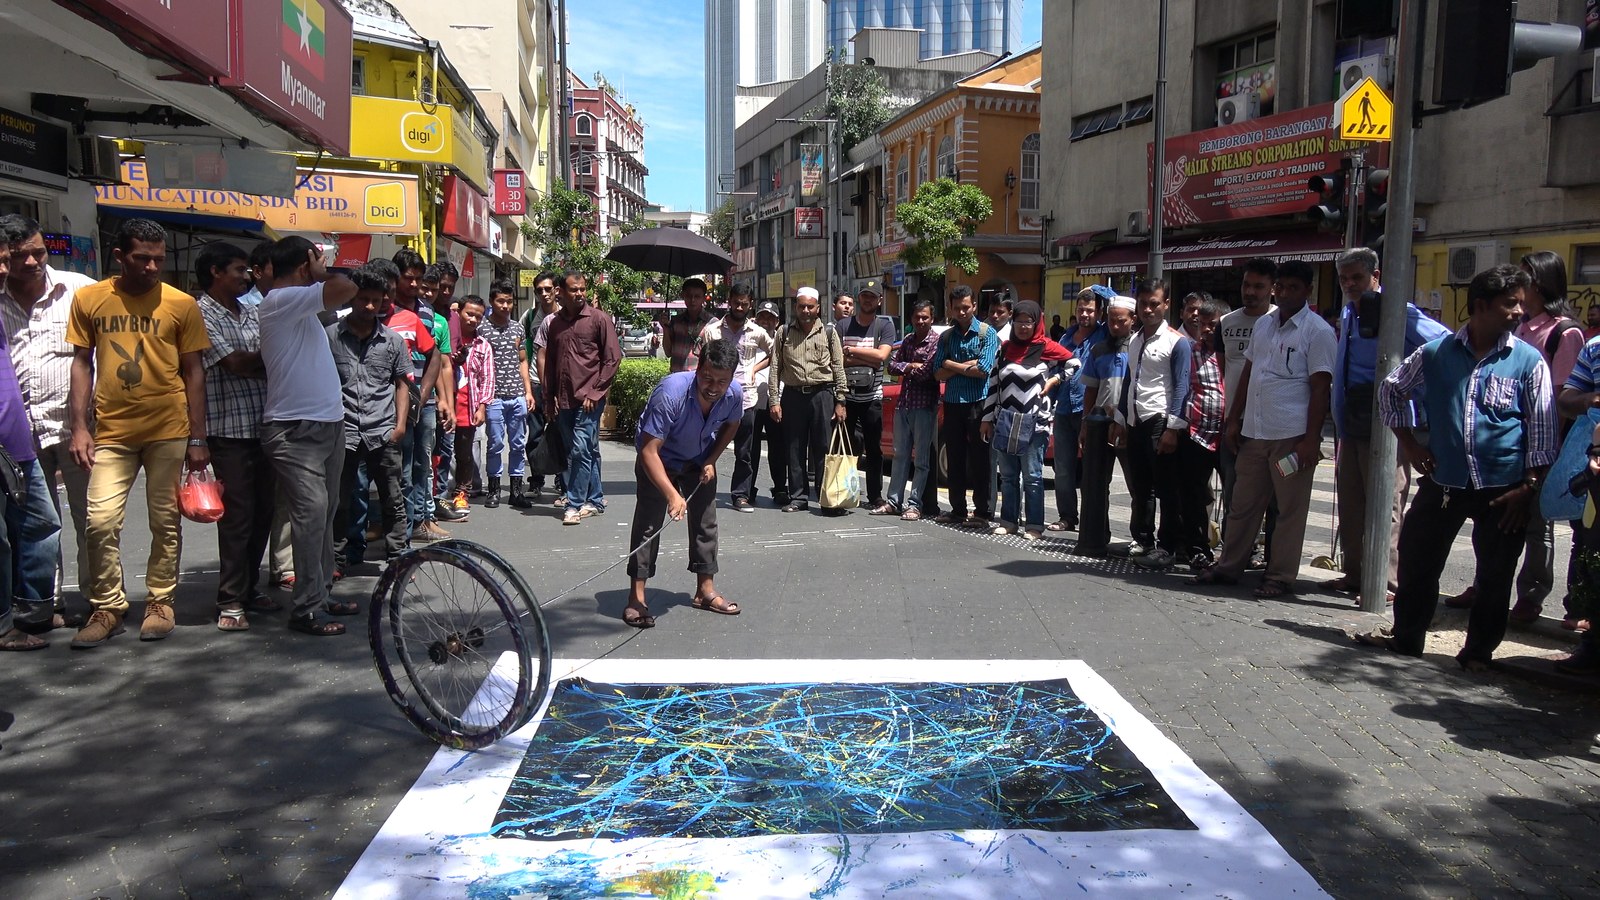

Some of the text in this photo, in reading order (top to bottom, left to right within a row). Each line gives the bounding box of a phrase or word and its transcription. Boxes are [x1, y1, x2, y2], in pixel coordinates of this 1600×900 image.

[281, 60, 326, 120] Myanmar
[1, 132, 37, 150] ENTERPRISE
[408, 128, 431, 144] digi
[1199, 129, 1263, 154] PEMBORONG
[1265, 116, 1327, 140] BARANGAN
[1184, 158, 1209, 177] MALIK
[1211, 150, 1253, 172] STREAMS
[1255, 136, 1326, 165] CORPORATION
[1214, 161, 1326, 187] IMPORT, EXPORT & TRADING
[259, 194, 298, 209] SDN
[306, 196, 348, 211] BHD
[508, 190, 521, 200] 3D
[371, 206, 399, 218] DiGi
[94, 314, 161, 336] PLAYBOY
